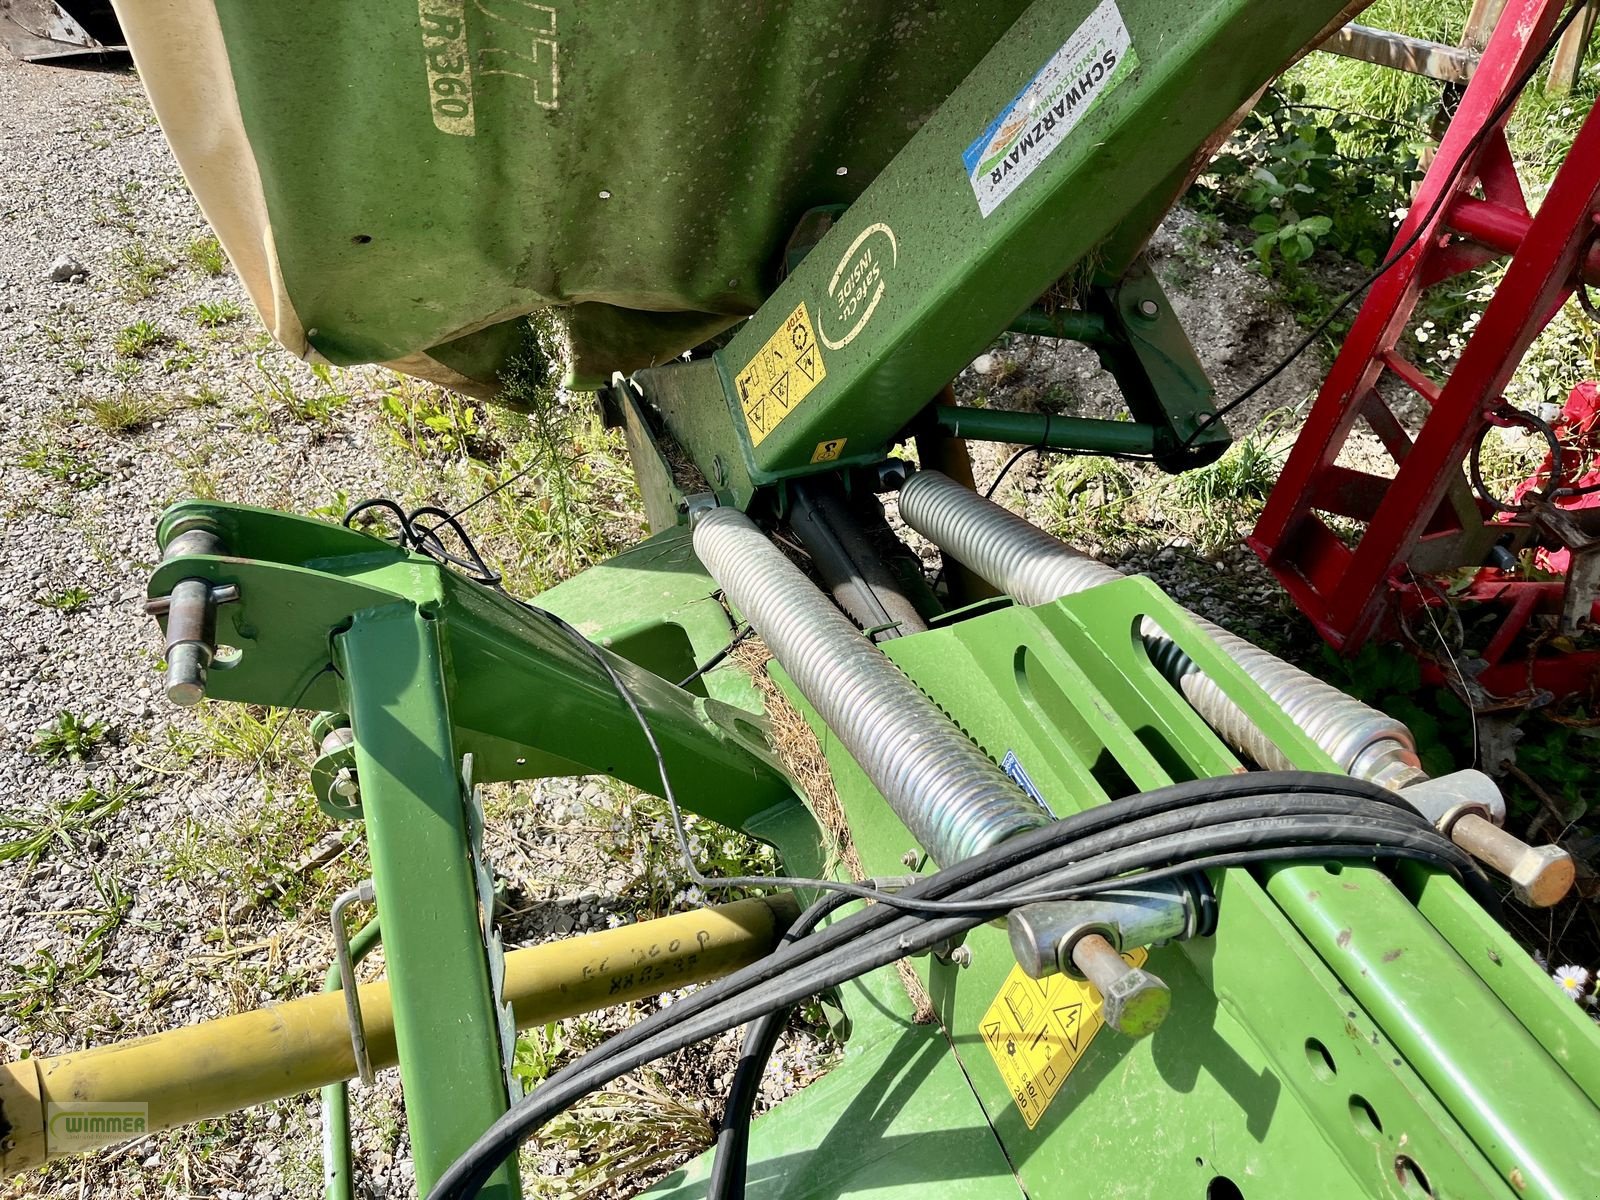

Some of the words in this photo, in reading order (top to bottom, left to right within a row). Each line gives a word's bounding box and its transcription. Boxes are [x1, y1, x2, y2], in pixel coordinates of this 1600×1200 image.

[1030, 38, 1107, 121] LANDTECHNIK
[990, 49, 1117, 186] SCHWARZMAYR
[836, 247, 872, 309] INSIDE
[786, 308, 804, 332] STOP
[1013, 1085, 1028, 1109] 200
